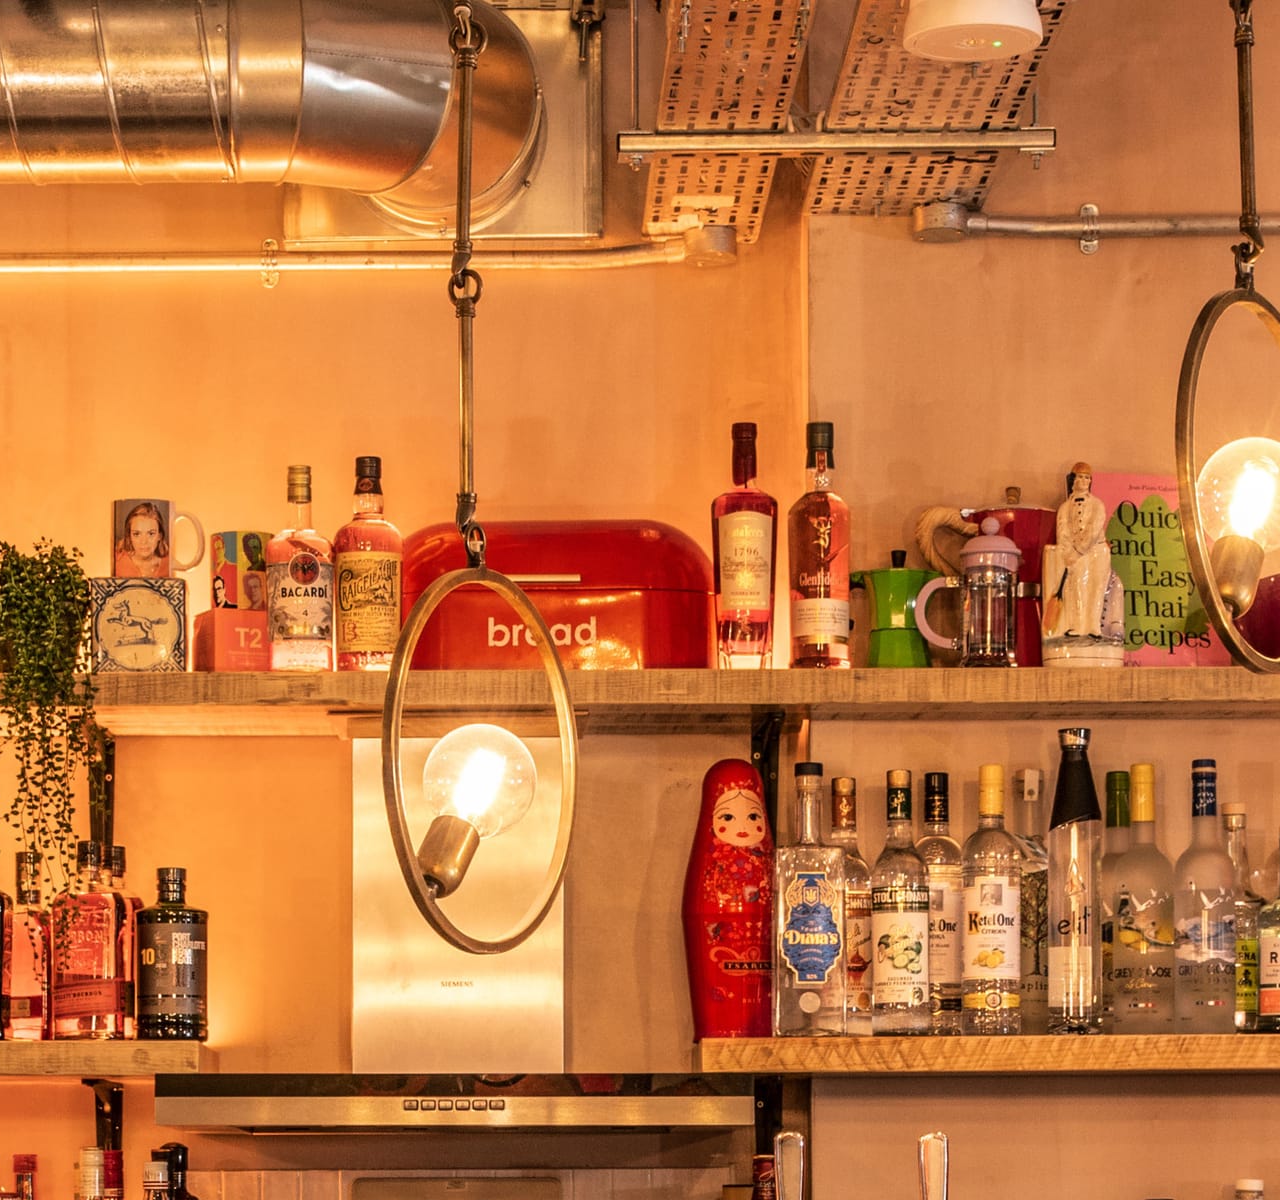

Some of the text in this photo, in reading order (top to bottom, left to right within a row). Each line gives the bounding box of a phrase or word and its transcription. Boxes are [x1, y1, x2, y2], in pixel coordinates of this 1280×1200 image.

[1116, 500, 1182, 535] Quic
[734, 547, 760, 557] 1796
[1110, 530, 1157, 557] and
[1141, 559, 1197, 595] Easy
[1124, 590, 1185, 619] Thai
[234, 627, 262, 648] T2
[1123, 624, 1212, 654] ecipes
[872, 891, 929, 904] STOLICHNAYA
[939, 918, 958, 932] One
[968, 912, 1016, 933] Ketel One
[784, 930, 839, 946] Dima's
[140, 947, 156, 966] 10
